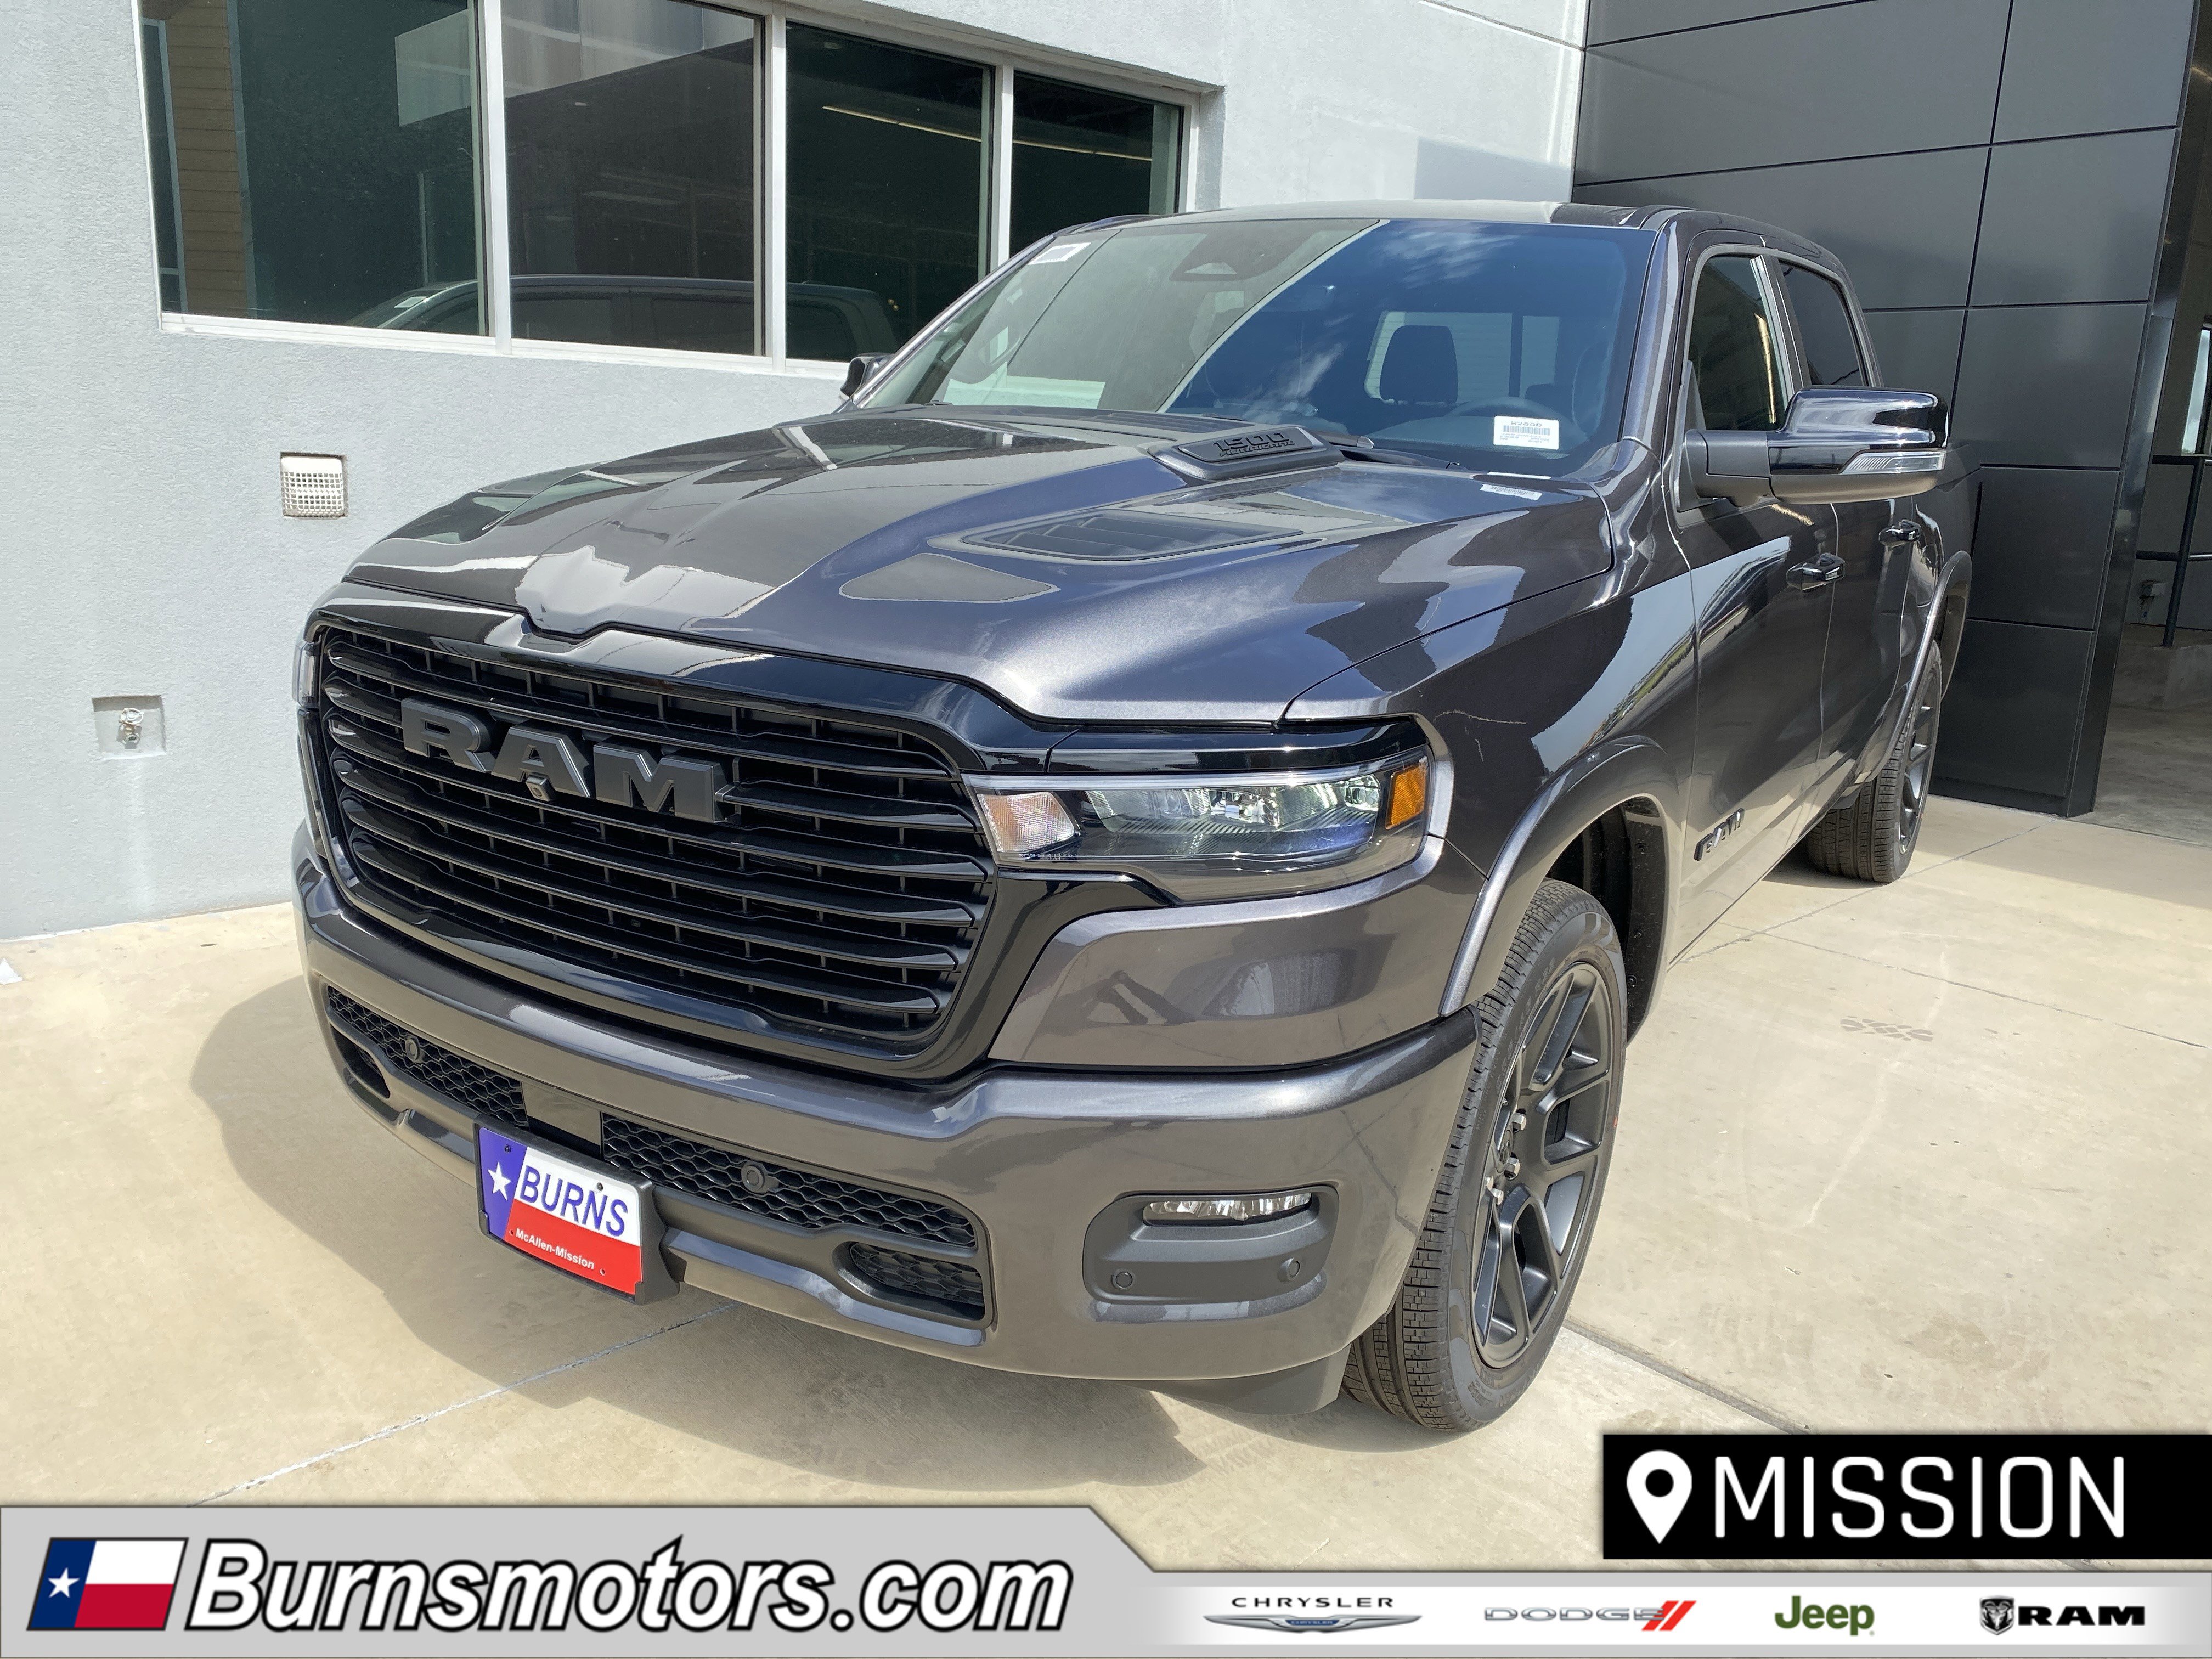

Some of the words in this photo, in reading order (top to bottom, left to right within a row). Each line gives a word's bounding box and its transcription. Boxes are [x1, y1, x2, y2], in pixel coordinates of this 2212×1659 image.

[1213, 432, 1290, 452] 1500
[1219, 440, 1296, 457] HURRICANE
[401, 696, 723, 823] RAM
[1693, 808, 1745, 861] RAM
[518, 1165, 628, 1237] BURNS
[515, 1228, 595, 1270] McAllen-Mission
